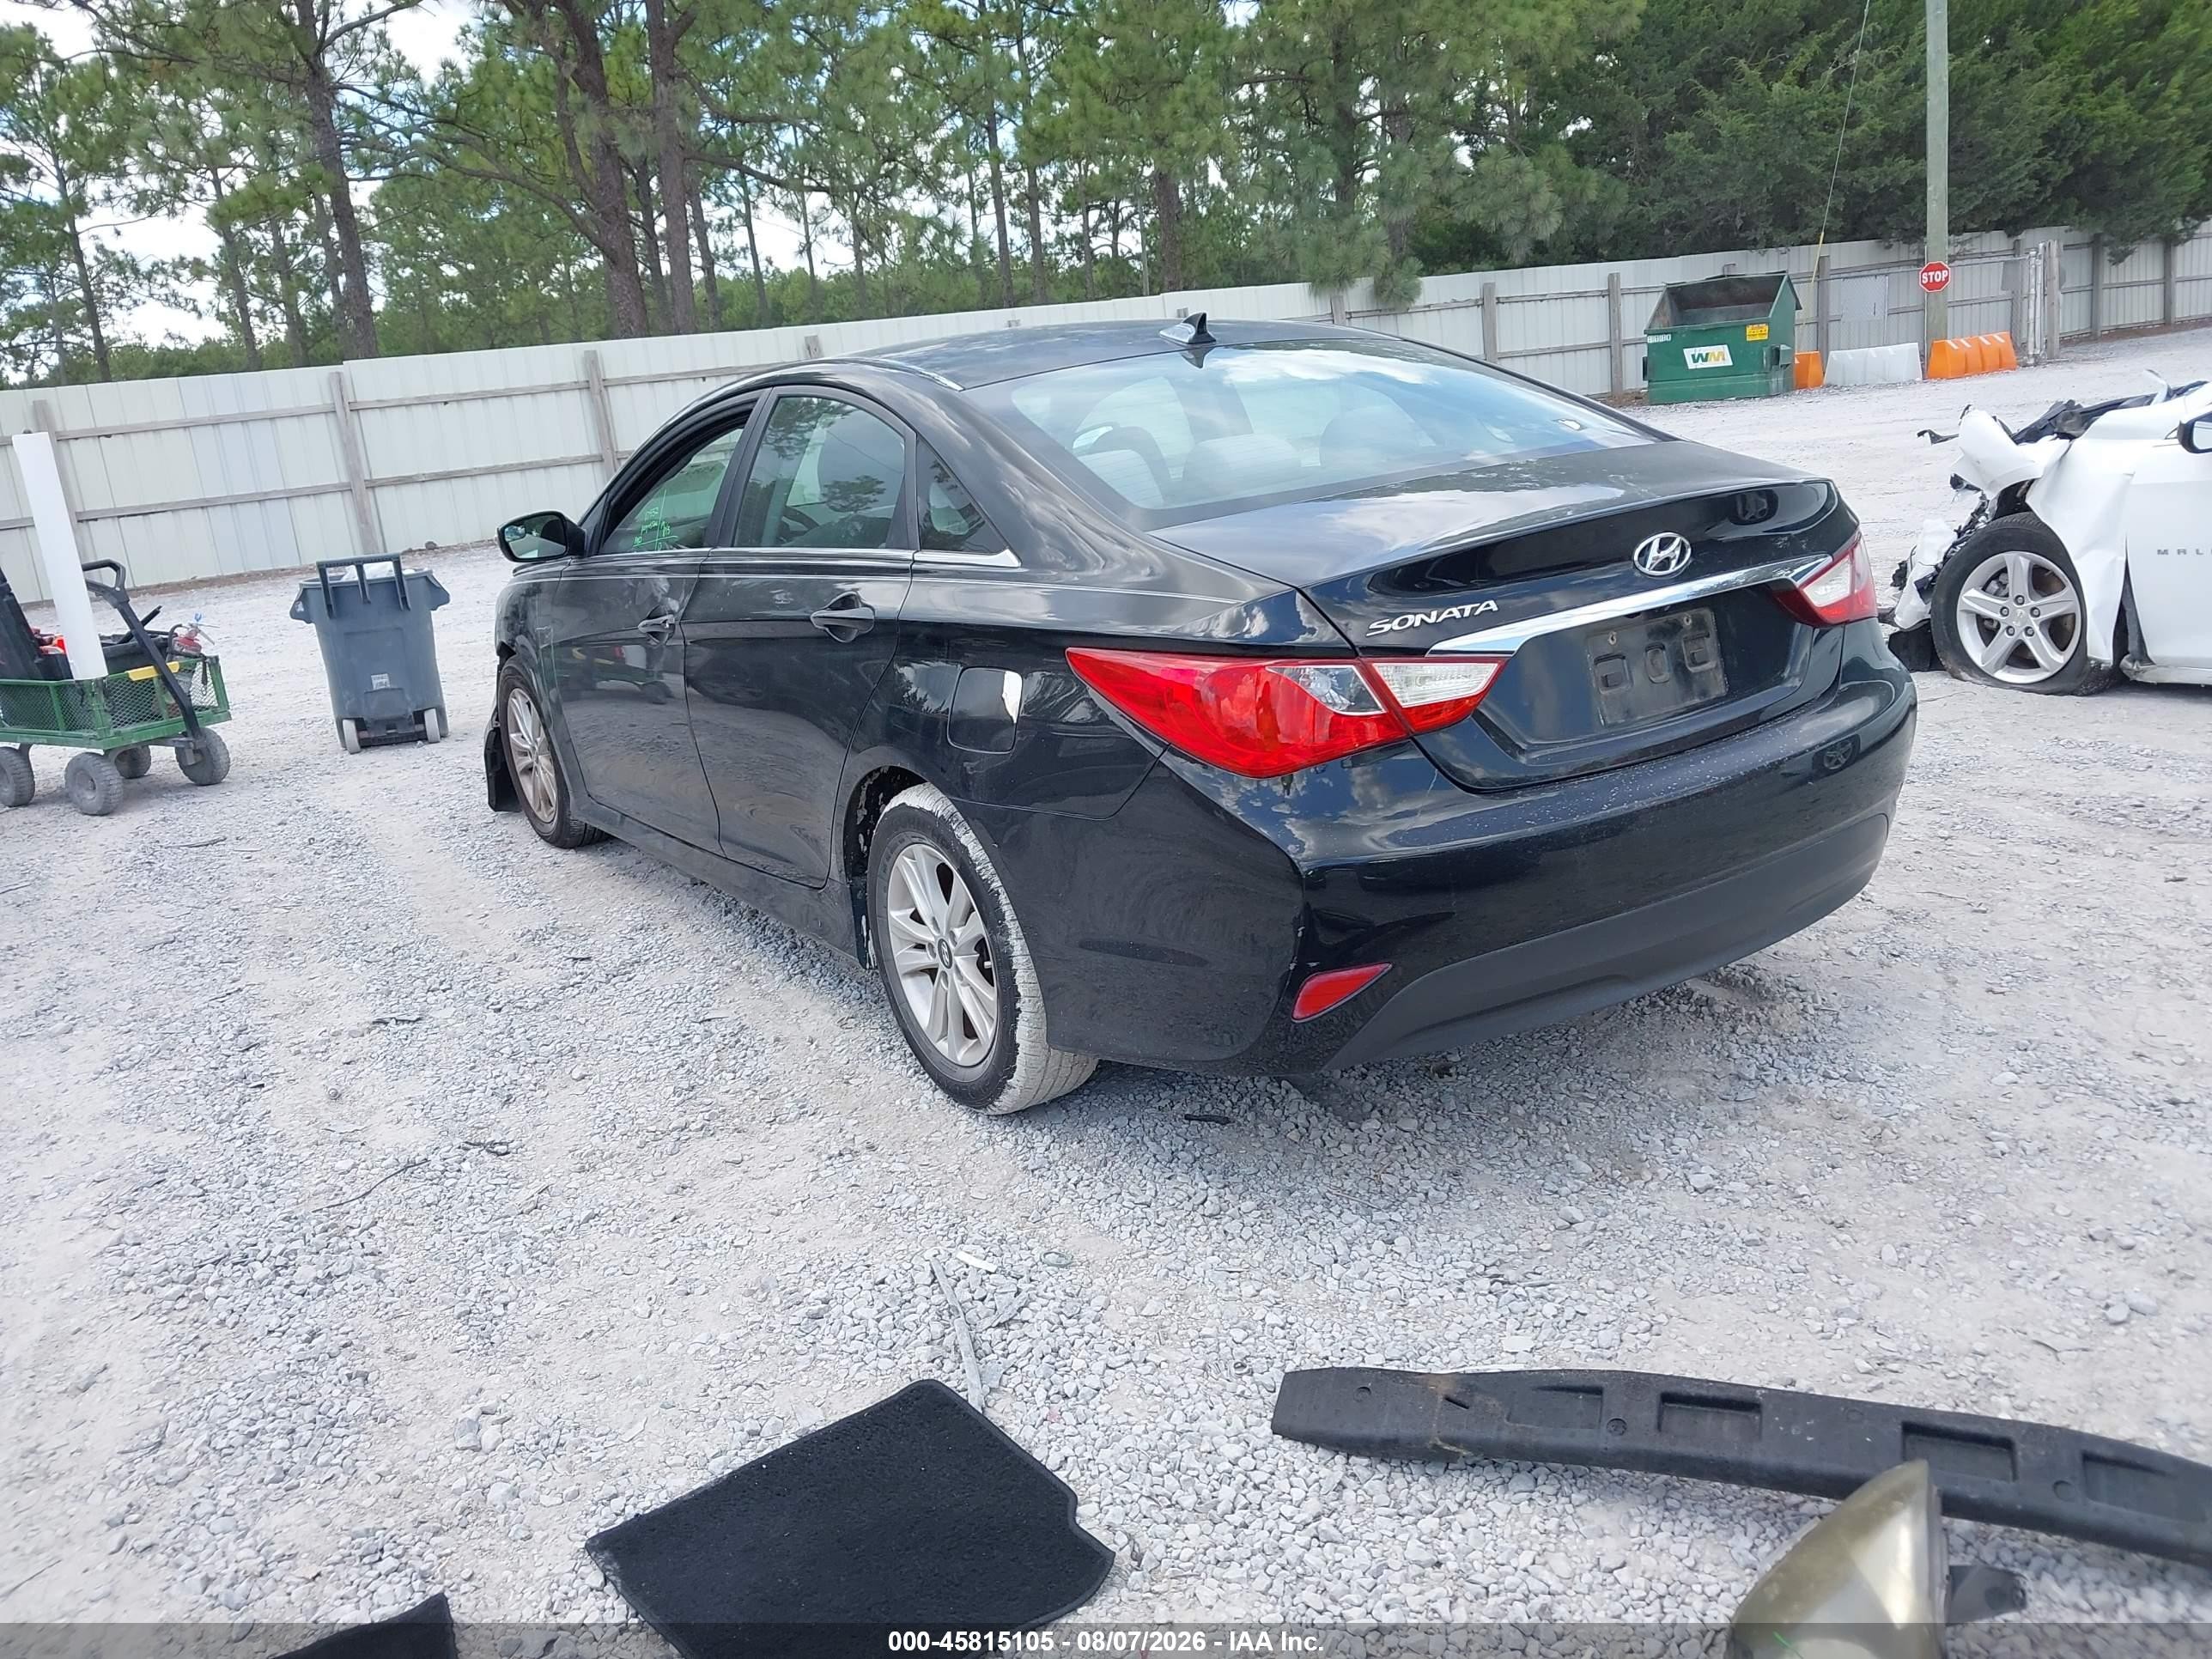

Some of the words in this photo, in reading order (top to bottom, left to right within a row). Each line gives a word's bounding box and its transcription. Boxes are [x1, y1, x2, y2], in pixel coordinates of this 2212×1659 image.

[1922, 270, 1948, 284] STOP
[1691, 351, 1725, 364] WM
[1366, 599, 1498, 637] SONATA
